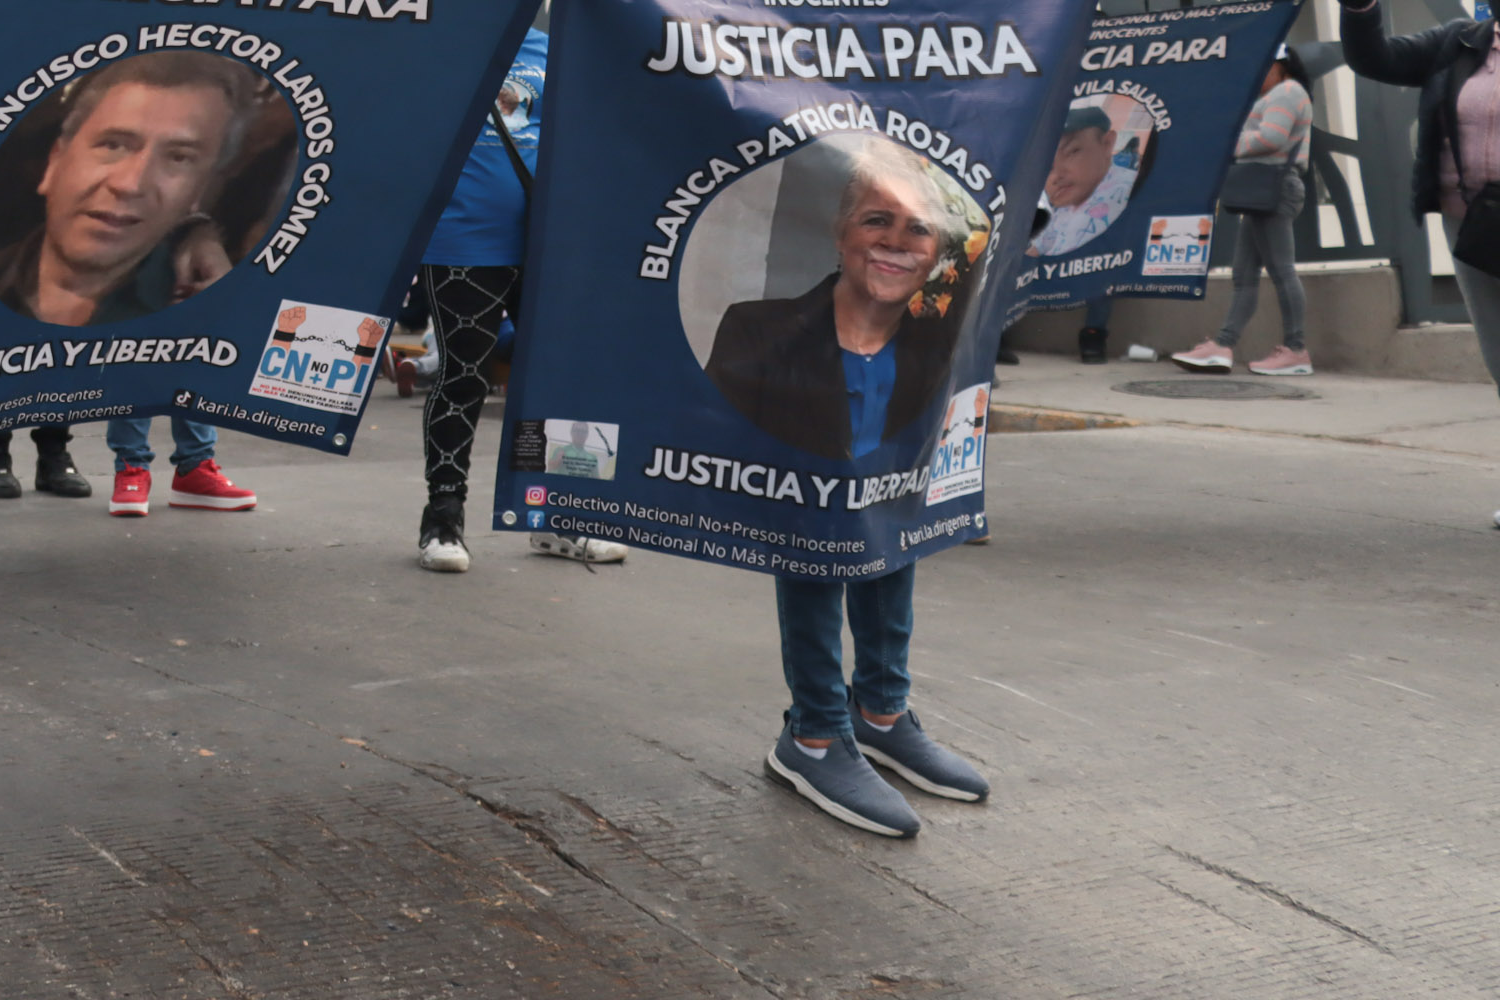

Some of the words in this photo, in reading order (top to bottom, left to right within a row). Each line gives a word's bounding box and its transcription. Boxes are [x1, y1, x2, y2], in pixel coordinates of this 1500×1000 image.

[1089, 25, 1169, 40] INOCENTES
[1160, 11, 1185, 22] NO
[1219, 1, 1275, 15] PRESOS
[138, 23, 282, 70] HECTOR
[647, 20, 875, 78] JUSTICIA
[883, 26, 1037, 76] PARA
[1081, 45, 1135, 71] CIA
[1141, 36, 1227, 65] PARA
[273, 59, 334, 160] LARIOS
[1117, 81, 1172, 132] SALAZAR
[640, 156, 740, 280] BLANCA
[736, 102, 878, 167] PATRICIA
[886, 109, 992, 192] ROJAS
[254, 161, 332, 275] GÓMEZ
[1043, 264, 1057, 280] Y
[1059, 250, 1133, 278] LIBERTAD
[62, 340, 85, 366] Y
[89, 337, 238, 367] LIBERTAD
[260, 346, 311, 383] CN
[311, 361, 329, 373] NO
[325, 359, 370, 394] PI
[17, 411, 64, 426] Presos
[67, 404, 133, 421] Inocentes
[36, 388, 103, 403] Inocentes
[197, 394, 326, 437] kari.la.dirigente
[645, 447, 805, 503] JUSTICIA
[810, 475, 840, 508] Y
[847, 466, 929, 510] LIBERTAD
[547, 492, 620, 514] Colectivo
[624, 502, 694, 528] Nacional
[699, 515, 787, 545] No+Presos
[791, 534, 865, 553] Inocentes
[550, 514, 624, 539] Colectivo
[628, 526, 698, 553] Nacional
[703, 541, 726, 559] No
[731, 547, 766, 567] Más
[771, 556, 828, 576] Presos
[832, 557, 885, 577] Inocentes
